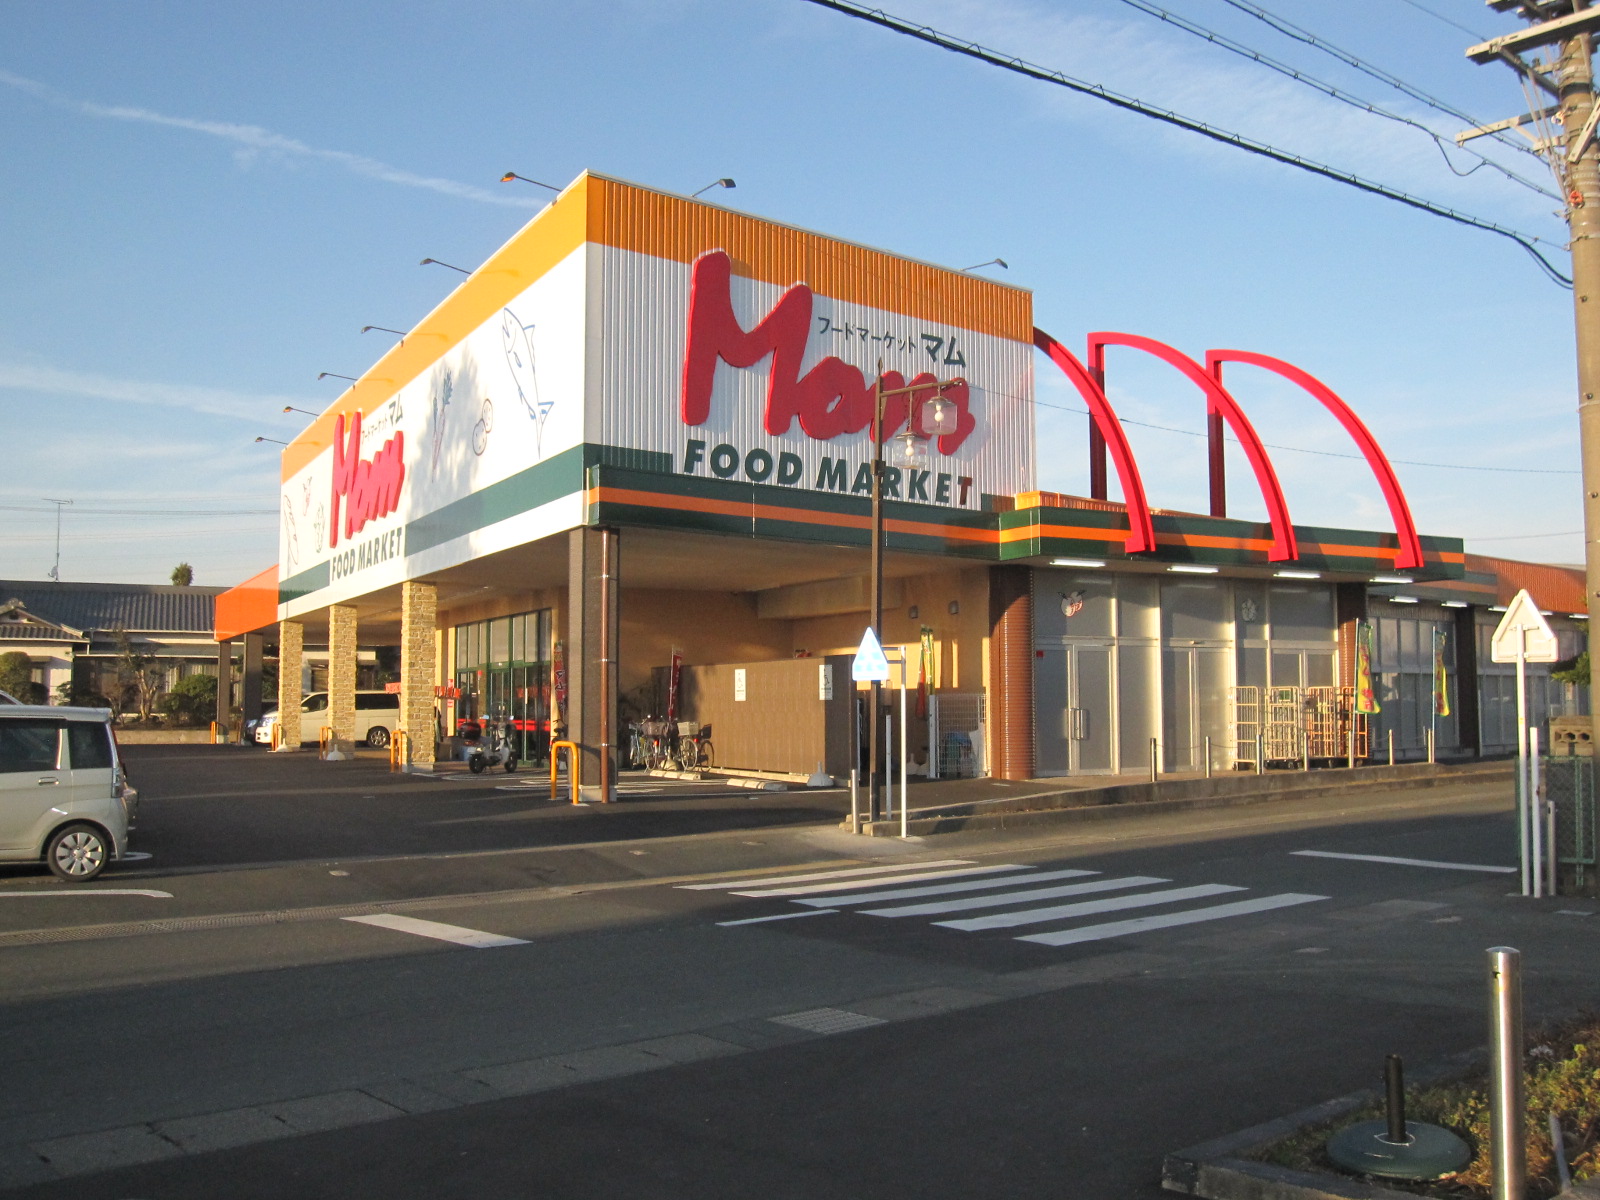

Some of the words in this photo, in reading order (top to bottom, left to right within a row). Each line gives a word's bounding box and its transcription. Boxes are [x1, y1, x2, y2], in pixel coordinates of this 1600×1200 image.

[818, 316, 917, 354] フードマーケット
[920, 332, 966, 368] マム
[388, 393, 403, 427] マム
[683, 438, 803, 485] FOOD
[815, 457, 973, 506] MARKET
[332, 548, 356, 581] FOOD
[357, 526, 402, 572] MARKET
